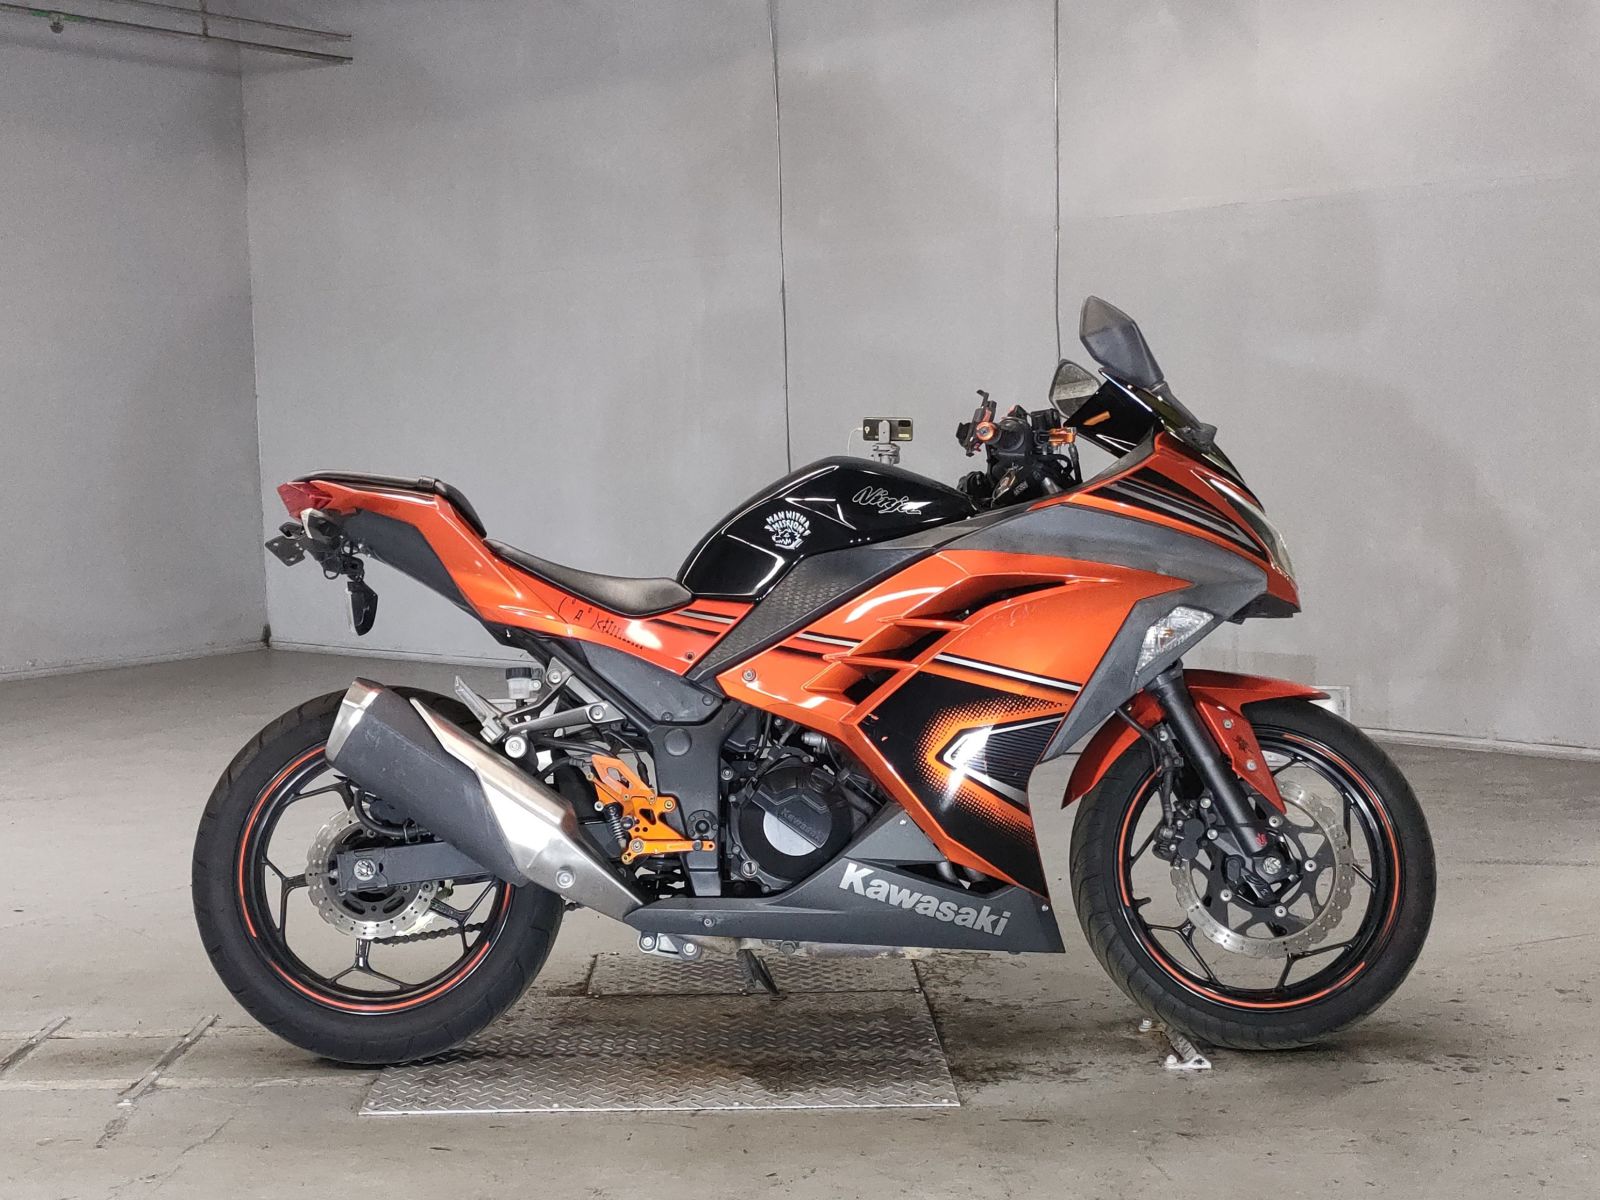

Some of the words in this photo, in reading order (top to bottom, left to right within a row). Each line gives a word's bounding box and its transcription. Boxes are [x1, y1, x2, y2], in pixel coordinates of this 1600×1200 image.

[852, 486, 922, 515] Ninja
[766, 511, 785, 524] MAN
[839, 863, 1011, 936] Kawasaki
